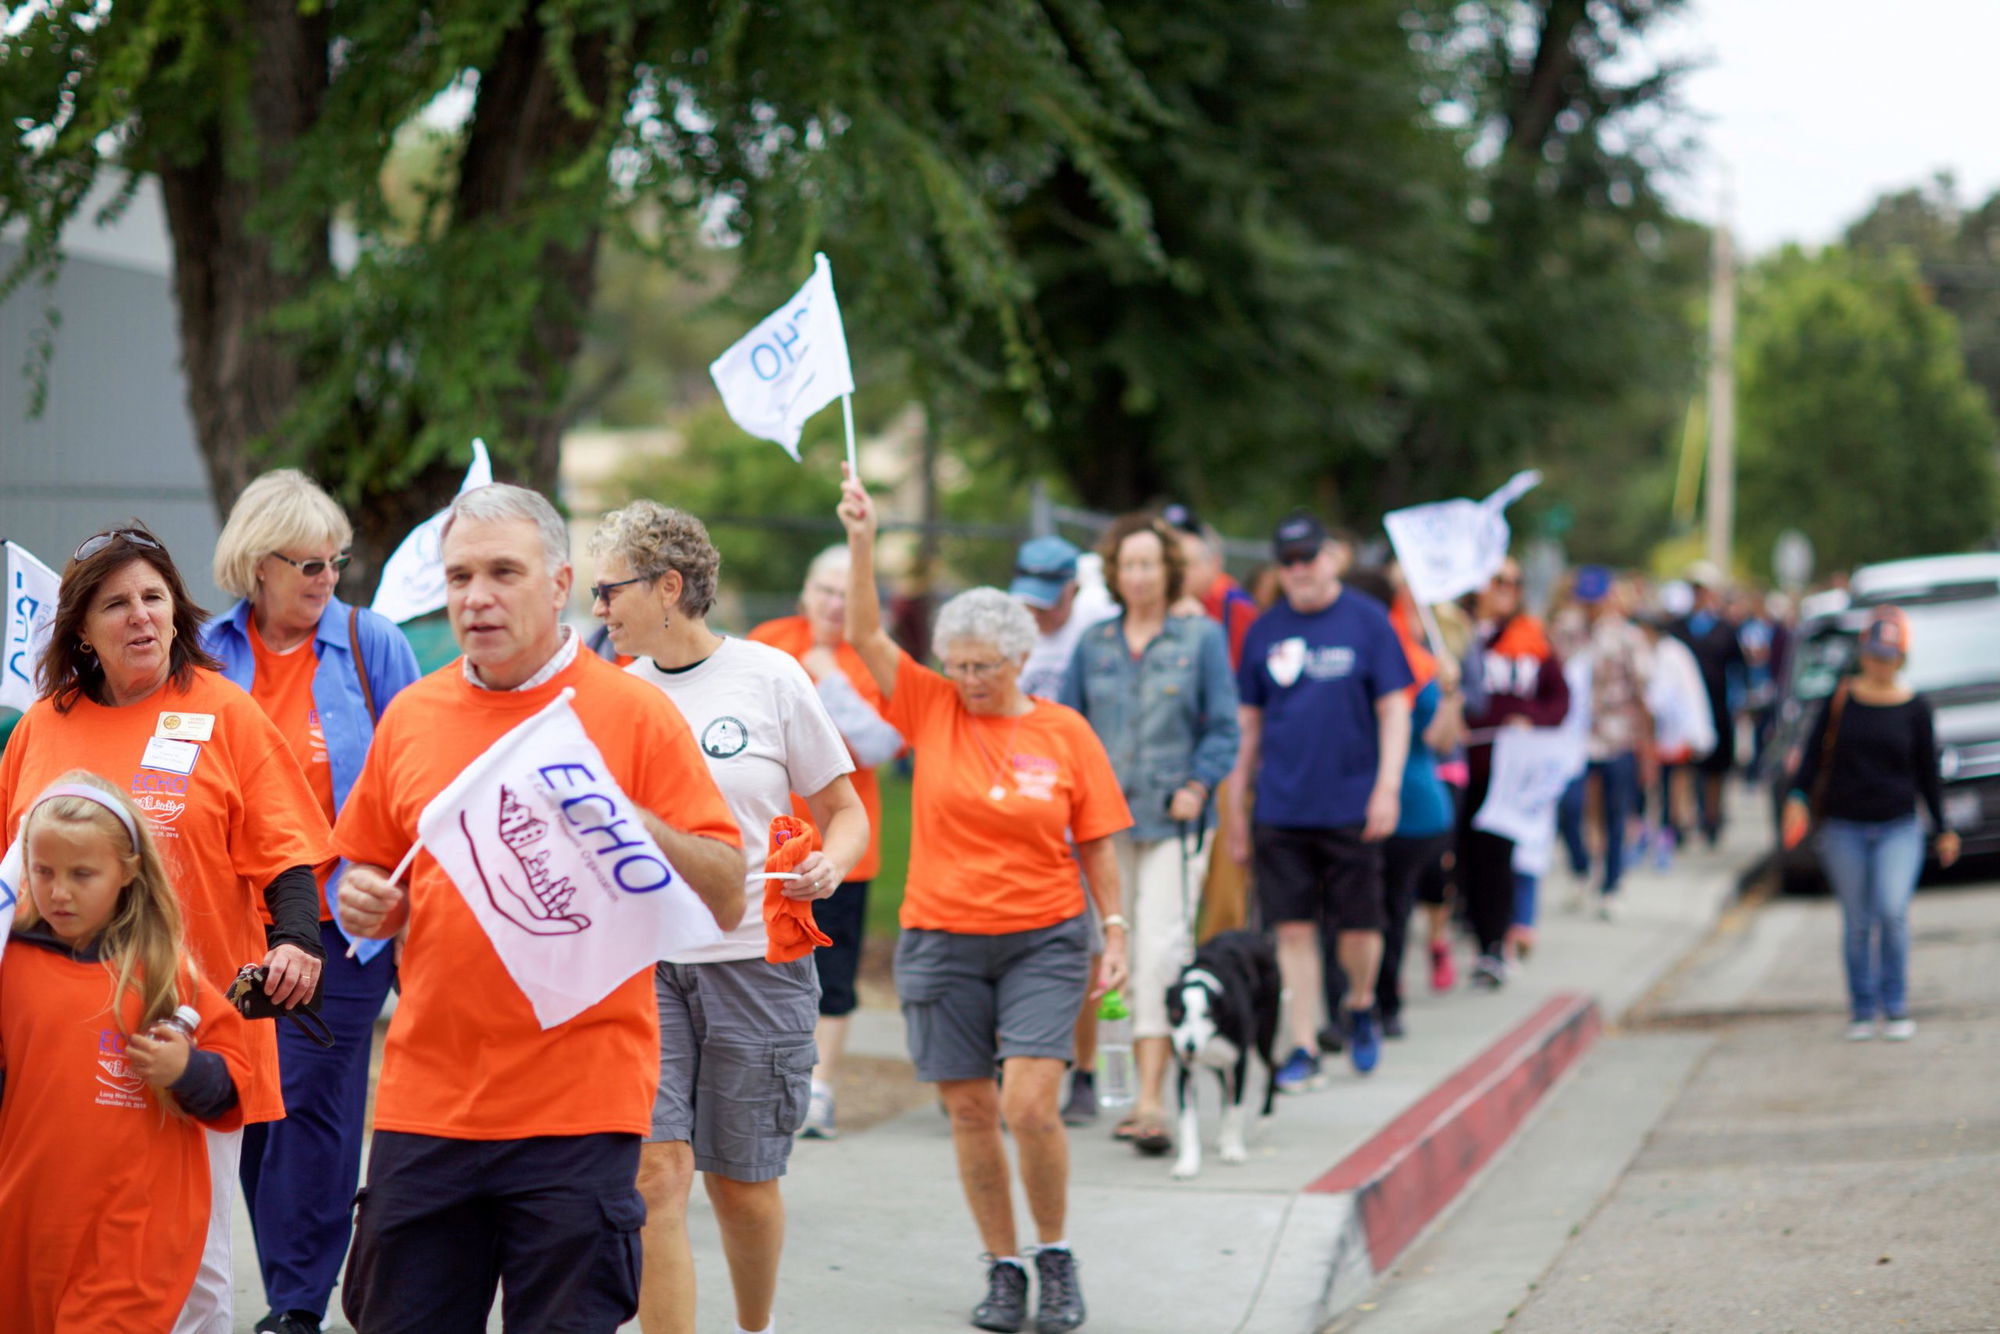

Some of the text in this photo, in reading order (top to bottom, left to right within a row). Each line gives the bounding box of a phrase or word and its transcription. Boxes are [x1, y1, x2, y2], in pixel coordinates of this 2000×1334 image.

[131, 774, 189, 793] ECHO
[538, 764, 672, 894] ECHO
[99, 1031, 126, 1054] EC
